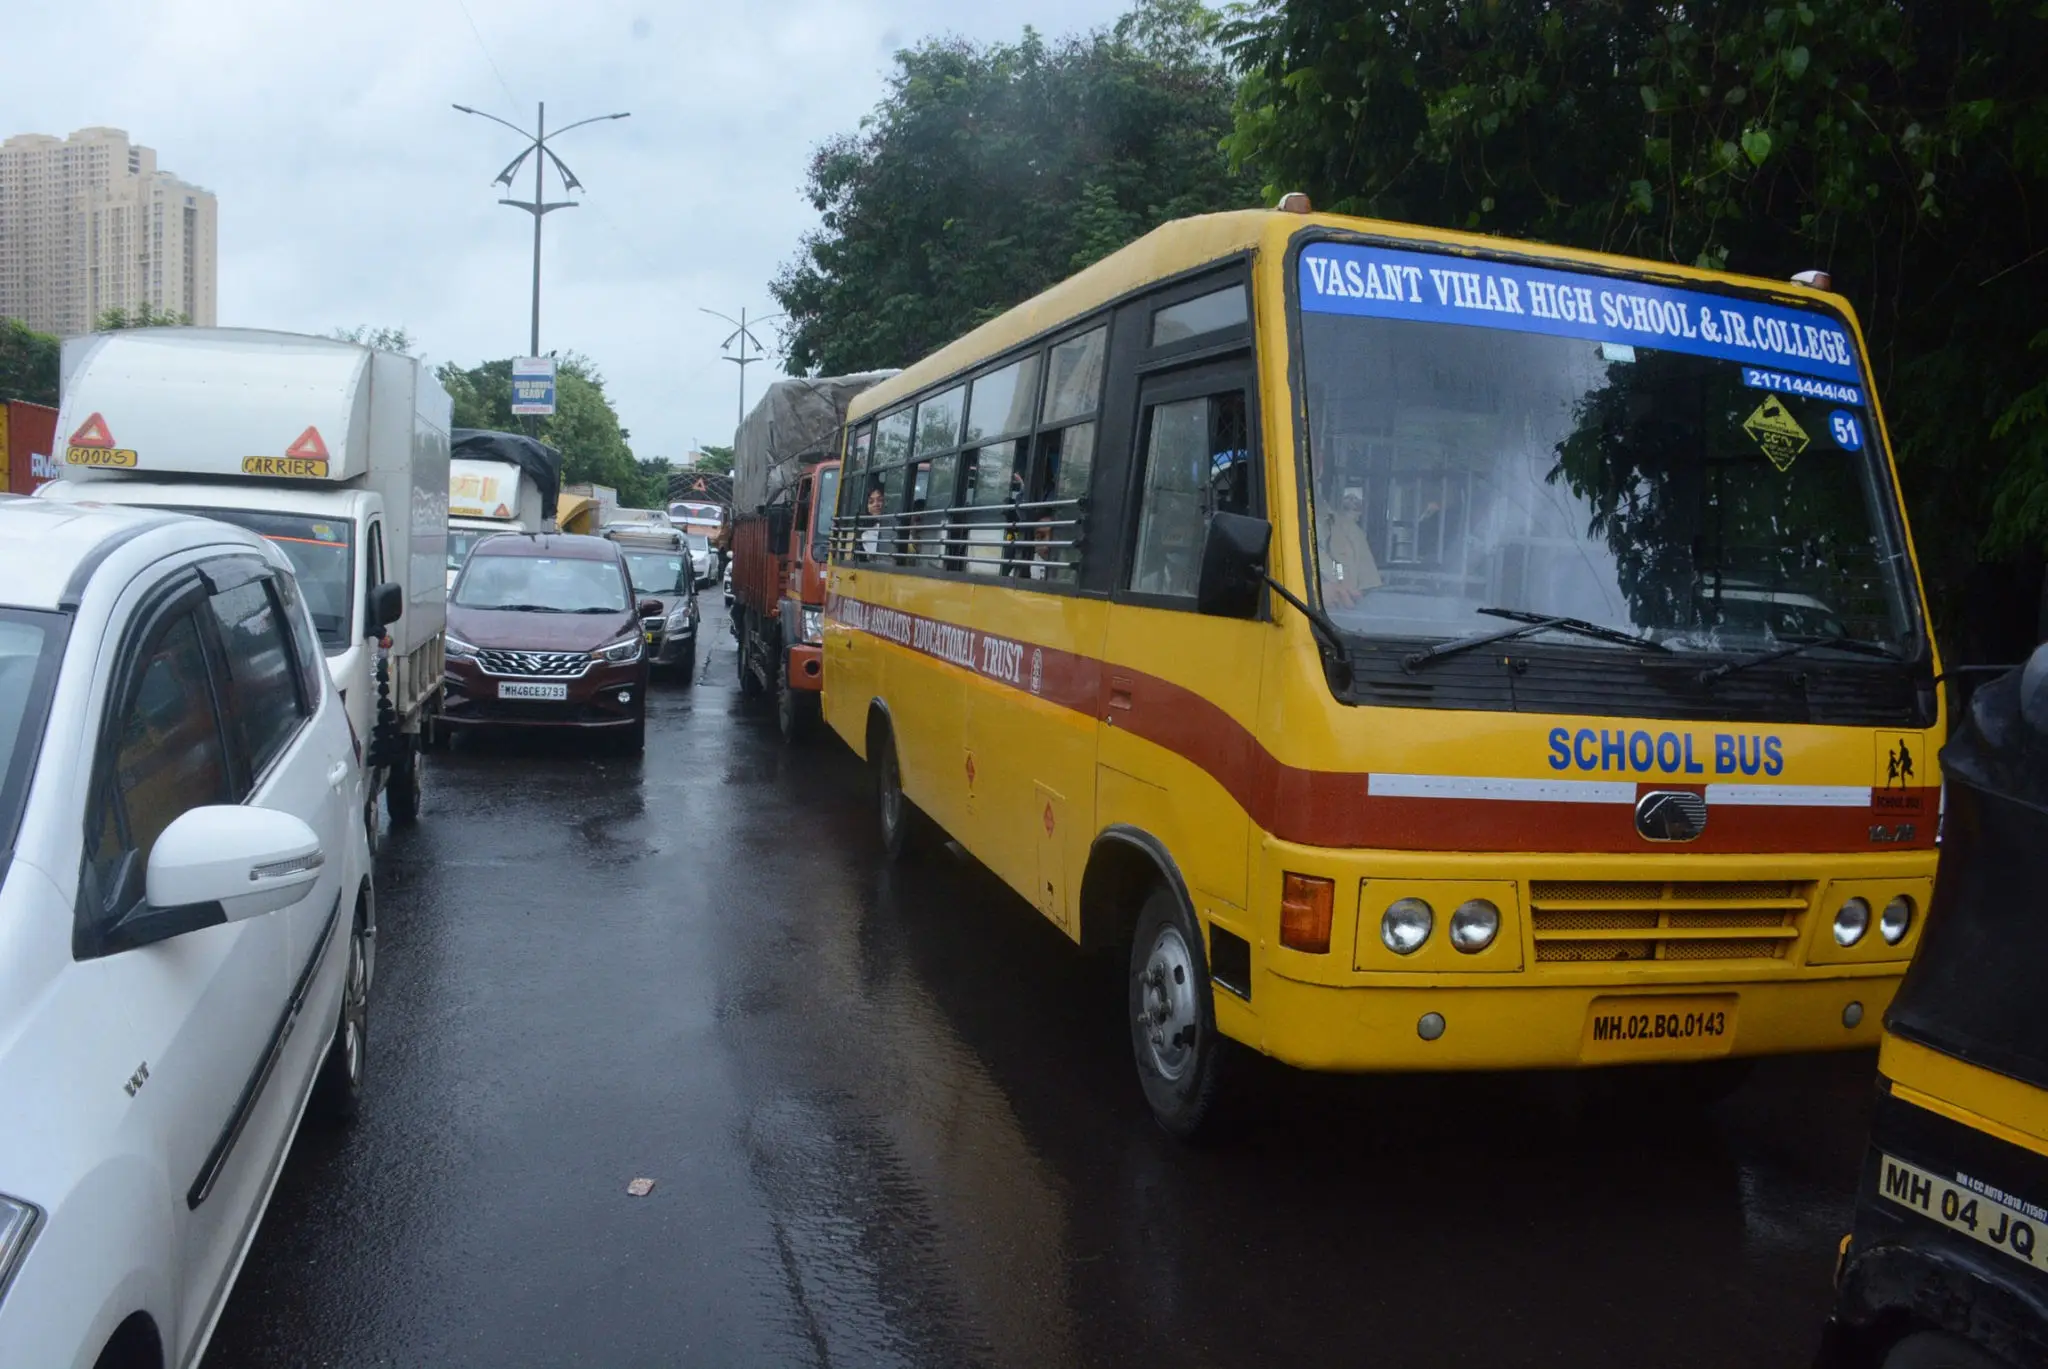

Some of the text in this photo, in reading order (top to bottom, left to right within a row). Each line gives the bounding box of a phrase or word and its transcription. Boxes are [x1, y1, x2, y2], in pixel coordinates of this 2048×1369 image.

[1306, 256, 1423, 303] VASANT
[1429, 268, 1525, 315] VIHAR
[1526, 280, 1597, 325] HIGH
[1600, 291, 1697, 339] SCHOOL
[1700, 306, 1722, 343] &
[1833, 416, 1859, 445] 51
[69, 449, 128, 465] GOODS
[245, 458, 318, 476] CARRIER
[871, 607, 911, 646] ASSOCIATES
[913, 618, 977, 668] EDUCATIONAL
[982, 636, 1024, 684] TRUST
[1548, 727, 1784, 776] SCHOOL BUS
[1593, 1012, 1725, 1041] MH.02.BQ.0143
[1885, 1163, 2036, 1261] MH 04 JQ
